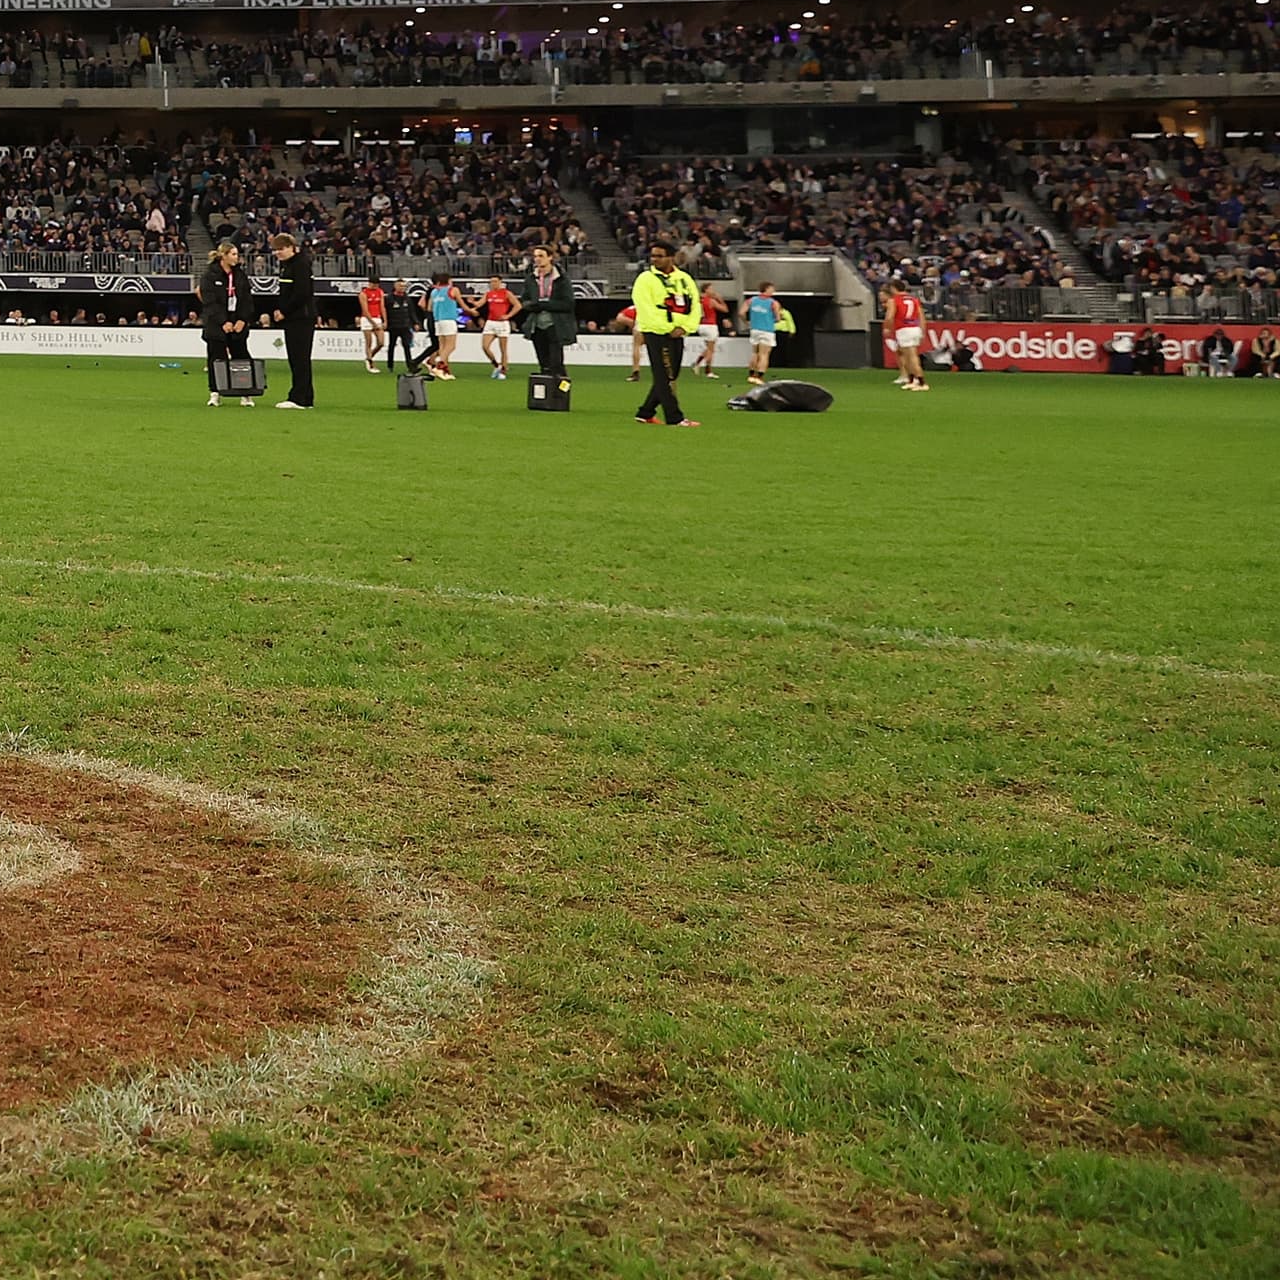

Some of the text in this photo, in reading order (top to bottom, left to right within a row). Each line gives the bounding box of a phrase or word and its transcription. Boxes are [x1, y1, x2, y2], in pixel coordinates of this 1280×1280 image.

[903, 299, 915, 319] 7
[1, 332, 145, 344] HAY SHED HILL WINES
[319, 337, 354, 348] SHED
[928, 329, 1097, 361] Woodside
